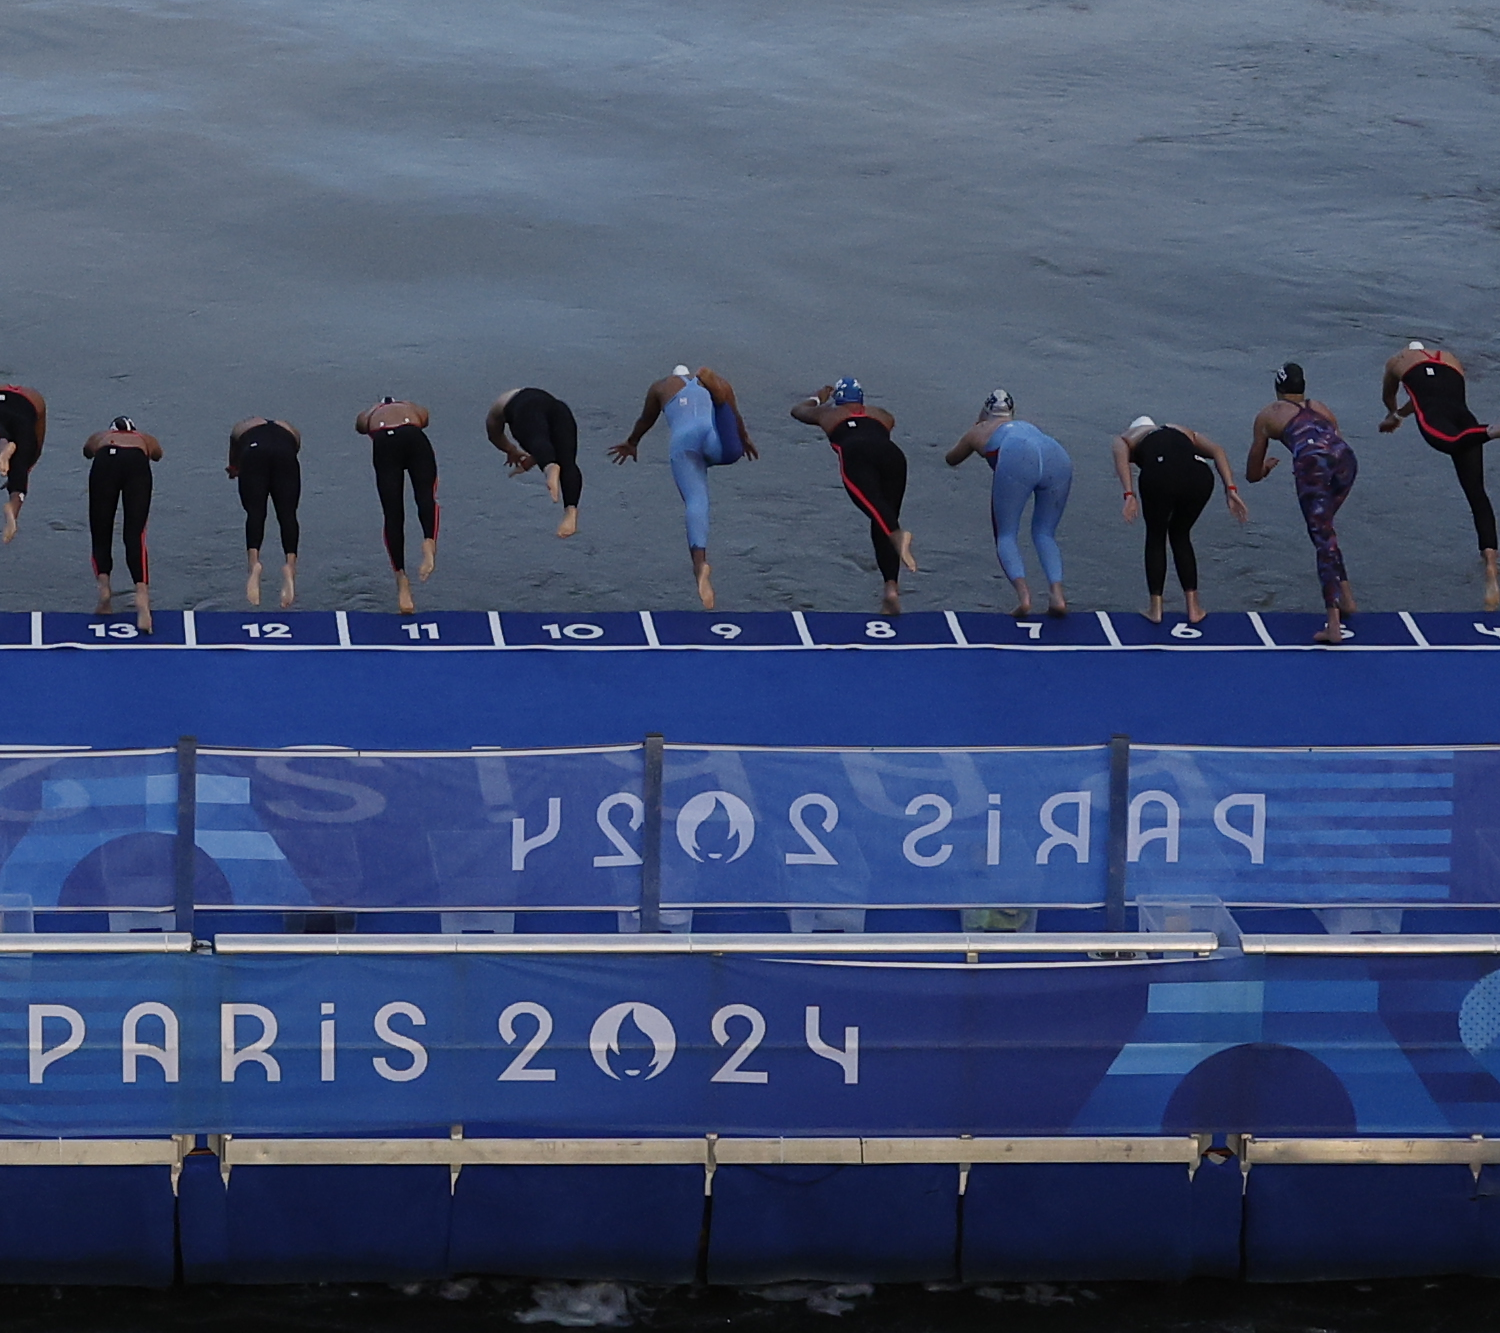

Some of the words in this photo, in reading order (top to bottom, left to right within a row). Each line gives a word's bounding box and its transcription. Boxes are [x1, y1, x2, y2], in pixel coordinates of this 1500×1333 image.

[88, 623, 139, 637] 13
[241, 623, 292, 638] 12
[401, 623, 440, 639] 11
[541, 623, 604, 639] 10
[710, 623, 742, 638] 9
[865, 621, 897, 638] 8
[1016, 623, 1043, 639] 7
[1170, 623, 1203, 639] 6
[497, 1001, 860, 1085] 2024
